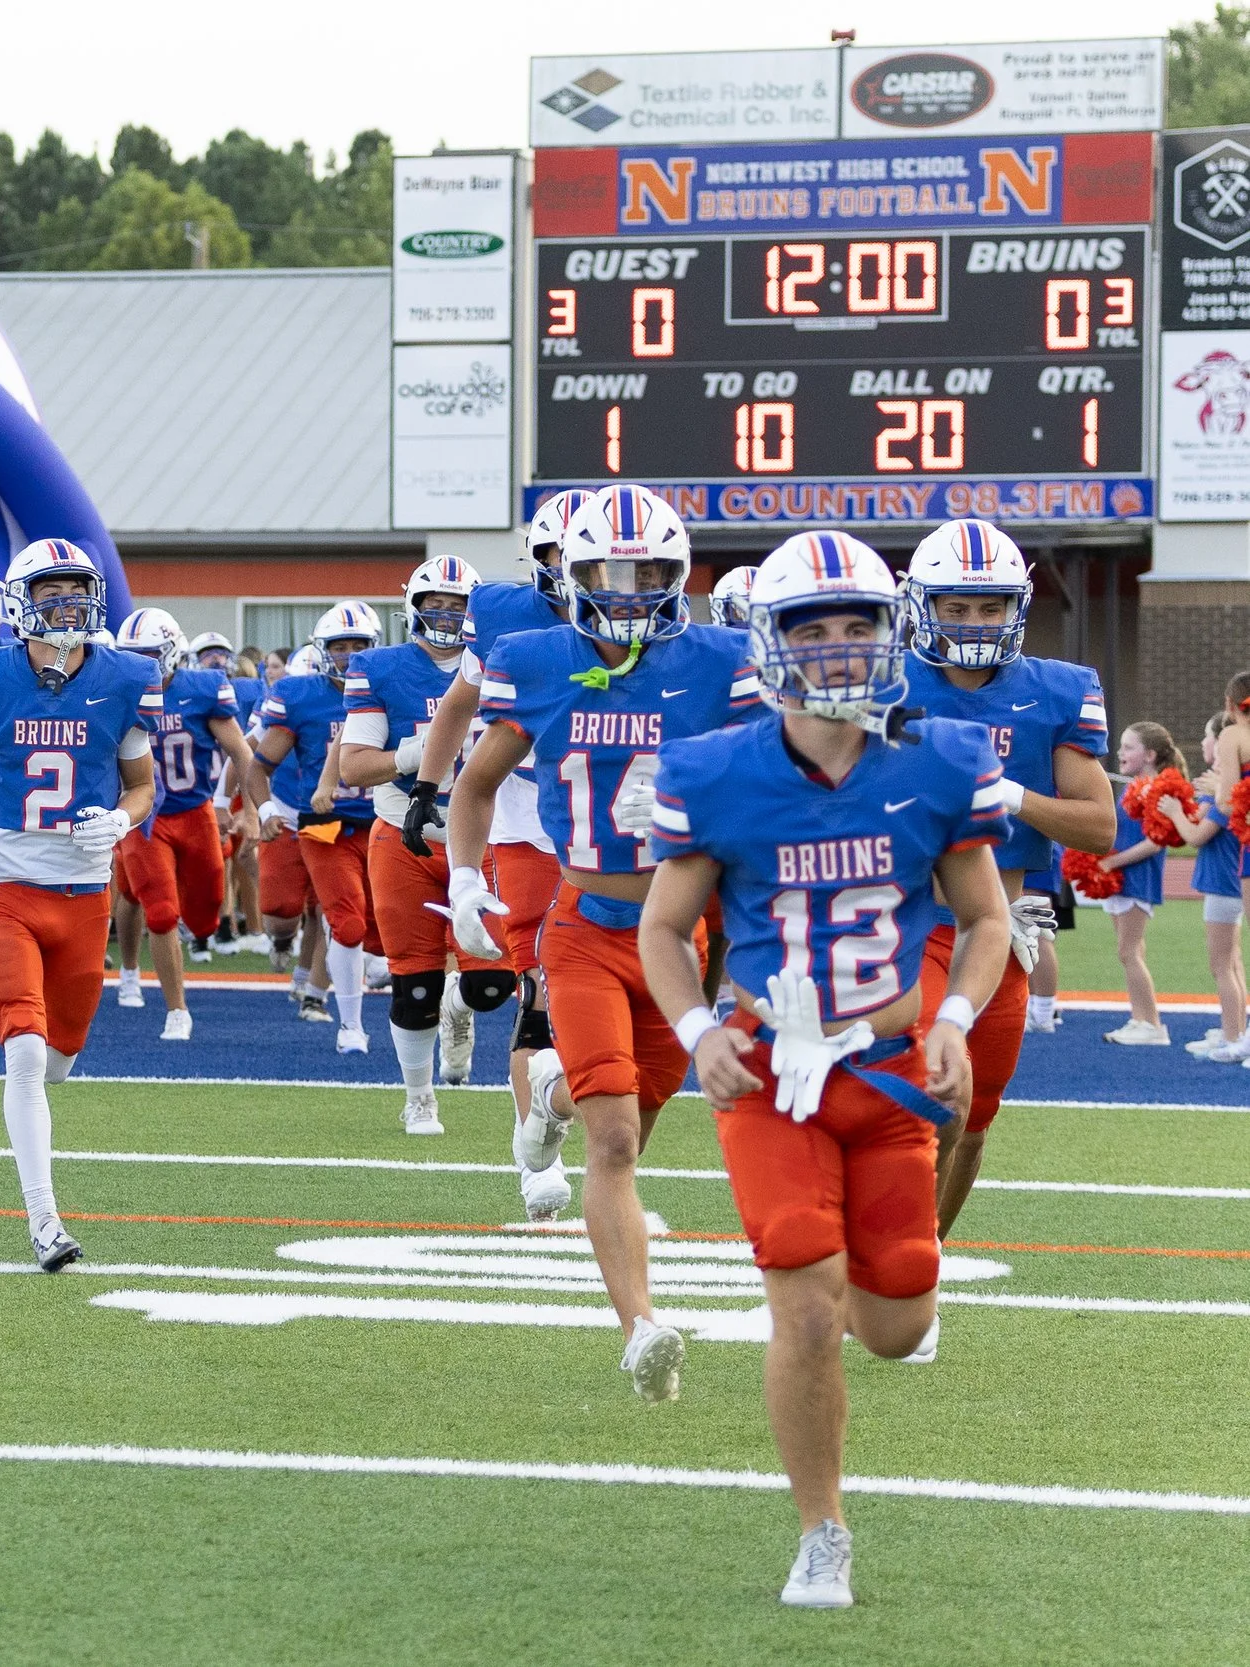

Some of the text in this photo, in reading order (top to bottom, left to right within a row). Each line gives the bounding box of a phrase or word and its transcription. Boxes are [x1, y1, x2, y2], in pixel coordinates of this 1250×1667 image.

[1003, 51, 1053, 65] Proud
[1059, 52, 1076, 64] to
[640, 79, 828, 104] Textile Rubber &
[882, 71, 976, 96] CARSTAR
[629, 103, 831, 129] Chemical Co. Inc.
[705, 155, 970, 184] NORTHWEST HIGH SCHOOL
[979, 146, 1057, 215] N
[622, 157, 697, 225] N
[697, 182, 974, 221] BRUINS FOOTBALL
[411, 232, 492, 251] COUNTRY
[965, 238, 1126, 274] BRUINS
[565, 248, 699, 282] GUEST
[765, 241, 937, 314] 12:00
[548, 289, 576, 335] 3
[1045, 279, 1090, 350] 0
[1103, 278, 1133, 325] 3
[632, 288, 676, 358] 0
[1096, 327, 1140, 348] TOL
[541, 337, 582, 357] TOL
[552, 374, 648, 401] DOWN
[703, 371, 797, 398] TO GO
[850, 367, 993, 396] BALL ON
[1038, 366, 1115, 394] QTR.
[606, 405, 621, 473] 1
[735, 402, 794, 472] 10
[875, 400, 964, 470] 20
[1083, 398, 1098, 468] 1
[719, 483, 936, 520] COUNTRY
[945, 482, 1104, 517] 98.3FM
[610, 546, 648, 555] Riddell
[817, 583, 857, 592] Riddell
[14, 719, 87, 746] BRUINS
[570, 711, 662, 746] BRUINS
[23, 750, 76, 836] 2
[558, 750, 663, 872] 14
[778, 835, 893, 883] BRUINS
[769, 881, 907, 1017] 12
